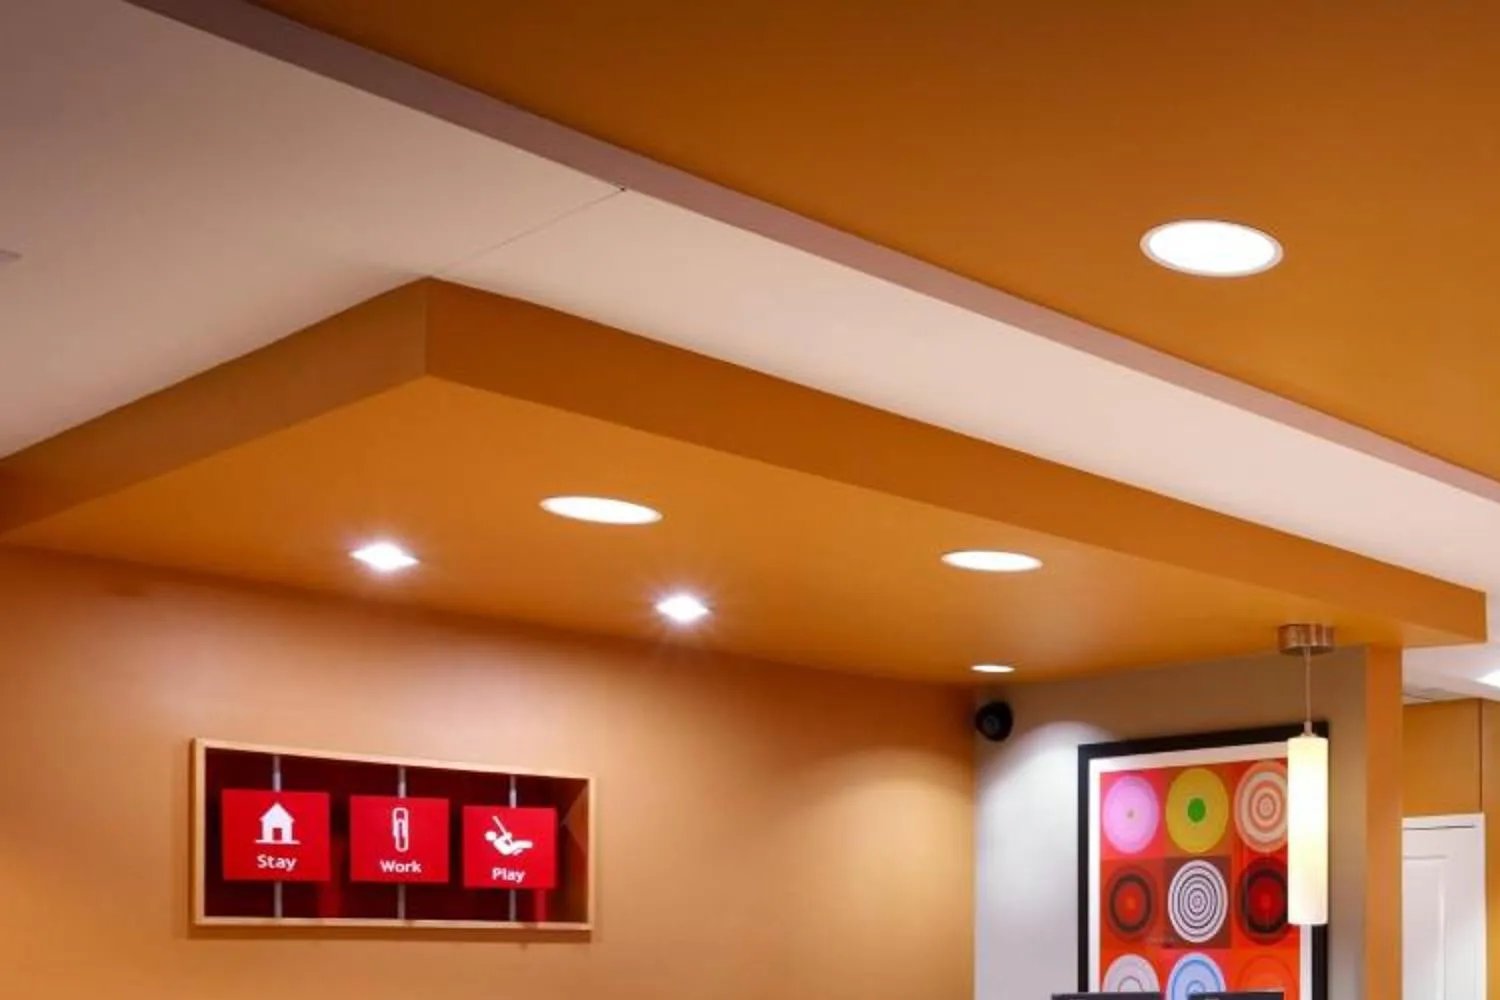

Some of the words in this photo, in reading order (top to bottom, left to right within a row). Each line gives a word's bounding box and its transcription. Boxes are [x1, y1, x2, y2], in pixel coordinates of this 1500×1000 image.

[256, 853, 297, 871] Stay
[380, 860, 422, 874] Work
[491, 867, 525, 883] Play
